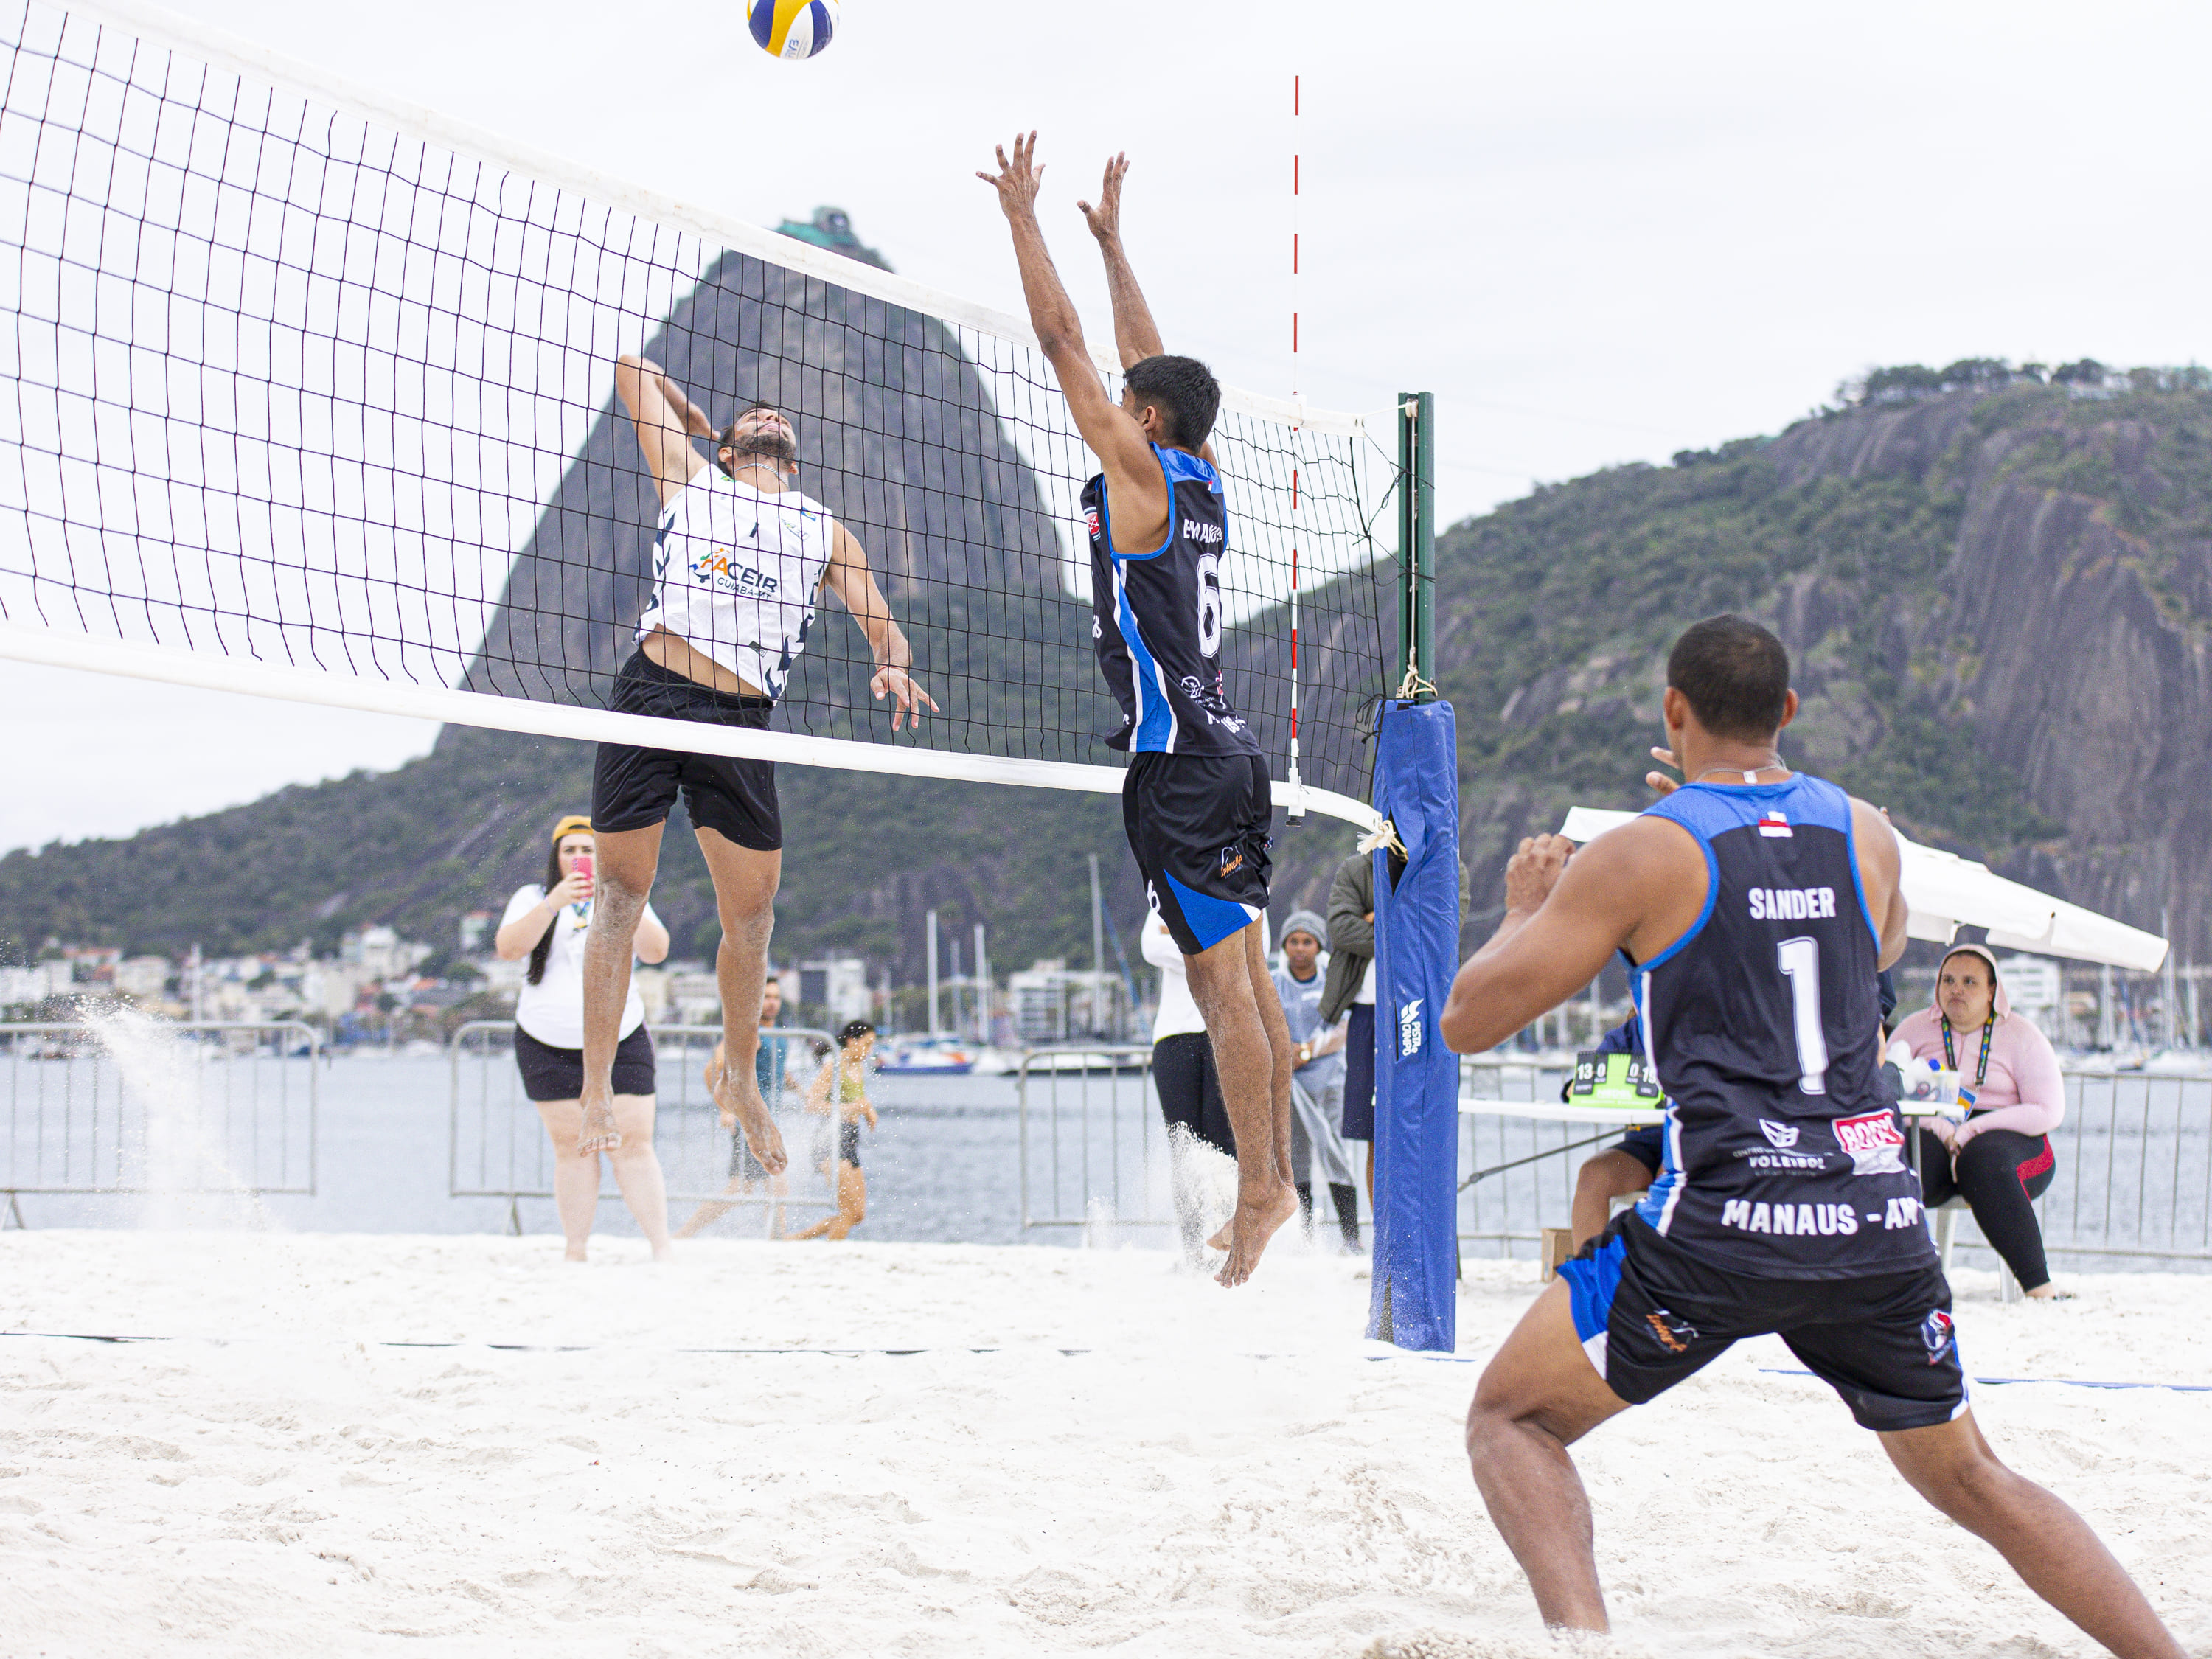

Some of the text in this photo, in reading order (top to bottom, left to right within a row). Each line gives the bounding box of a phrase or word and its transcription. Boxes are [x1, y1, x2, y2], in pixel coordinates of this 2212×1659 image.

[711, 557, 778, 593] ACEIR
[1197, 554, 1222, 658] 6
[1147, 879, 1161, 911] 6
[1748, 887, 1836, 920] SANDER
[1777, 936, 1829, 1095] 1
[1402, 1023, 1412, 1057] CAMPO
[1577, 1062, 1593, 1081] 13
[1597, 1062, 1606, 1078] 0
[1629, 1062, 1639, 1077] 0
[1721, 1199, 1859, 1236] MANAUS
